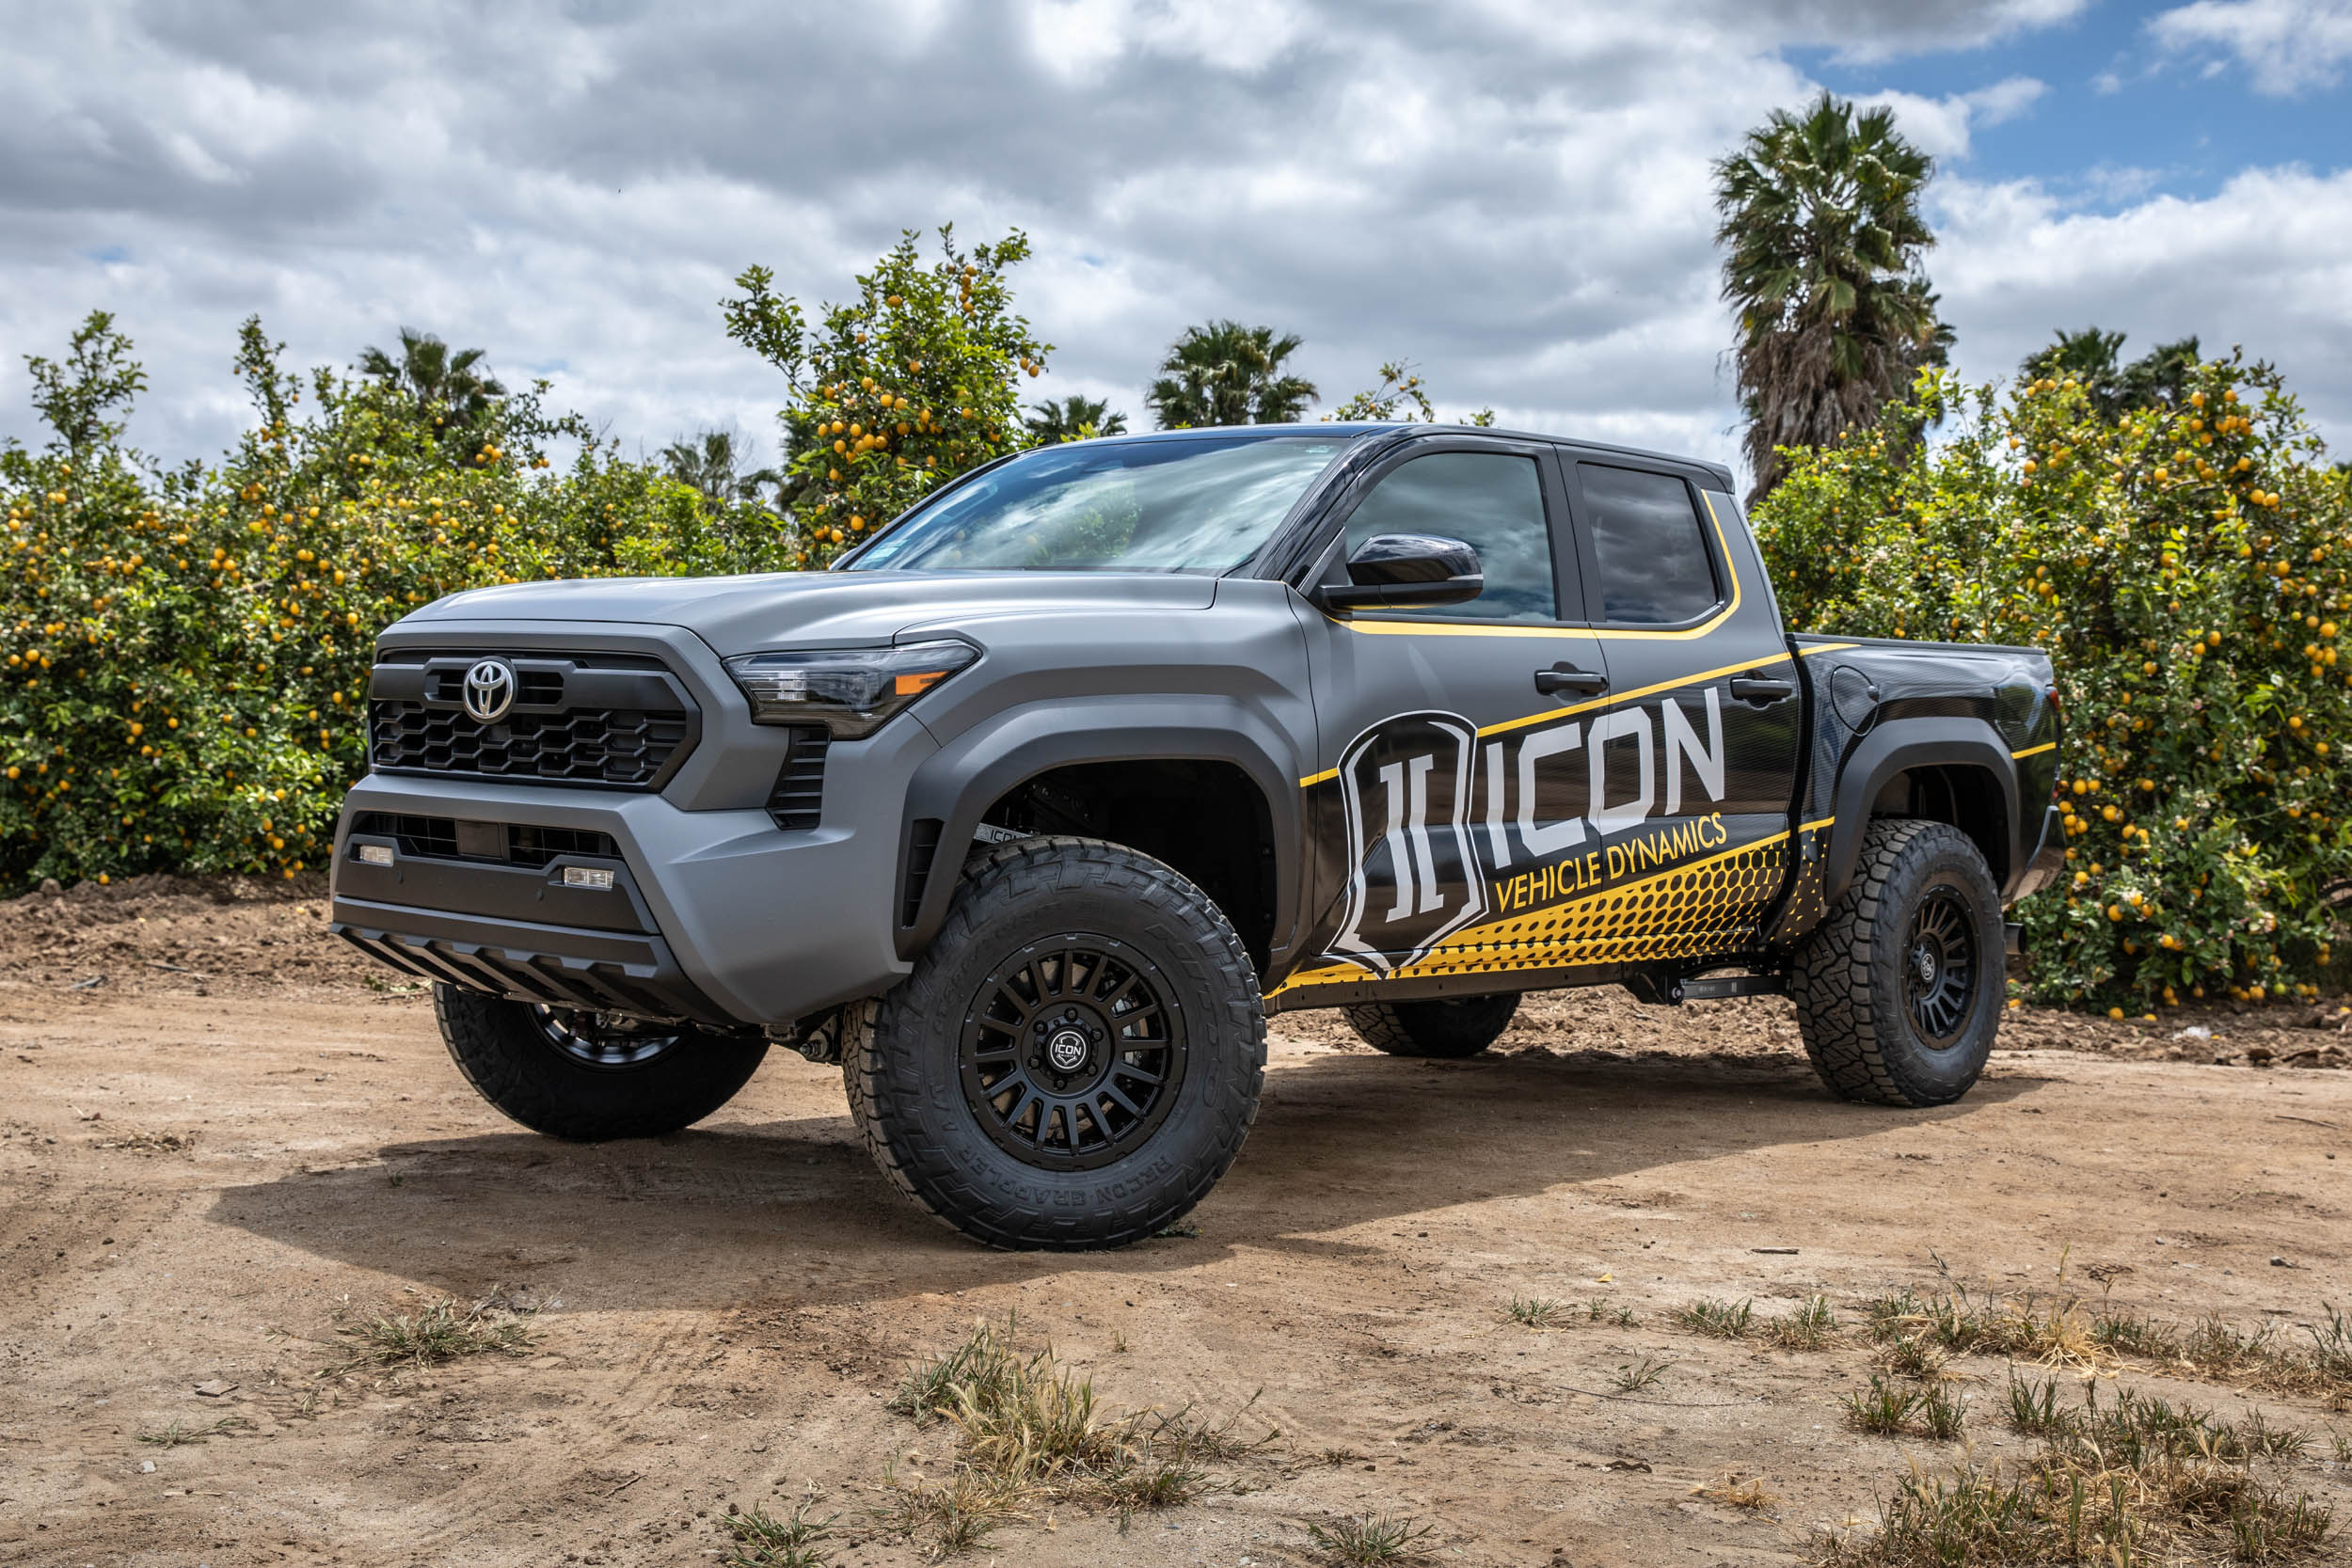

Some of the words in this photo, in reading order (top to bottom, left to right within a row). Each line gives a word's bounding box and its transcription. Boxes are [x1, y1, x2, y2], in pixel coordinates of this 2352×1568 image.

[1486, 687, 1725, 869] ICON
[1496, 851, 1601, 913] VEHICLE
[1606, 812, 1727, 879] DYNAMICS
[1055, 1044, 1082, 1055] ICON
[959, 1144, 1088, 1207] GRAPPLER
[1094, 1154, 1175, 1205] RECON
